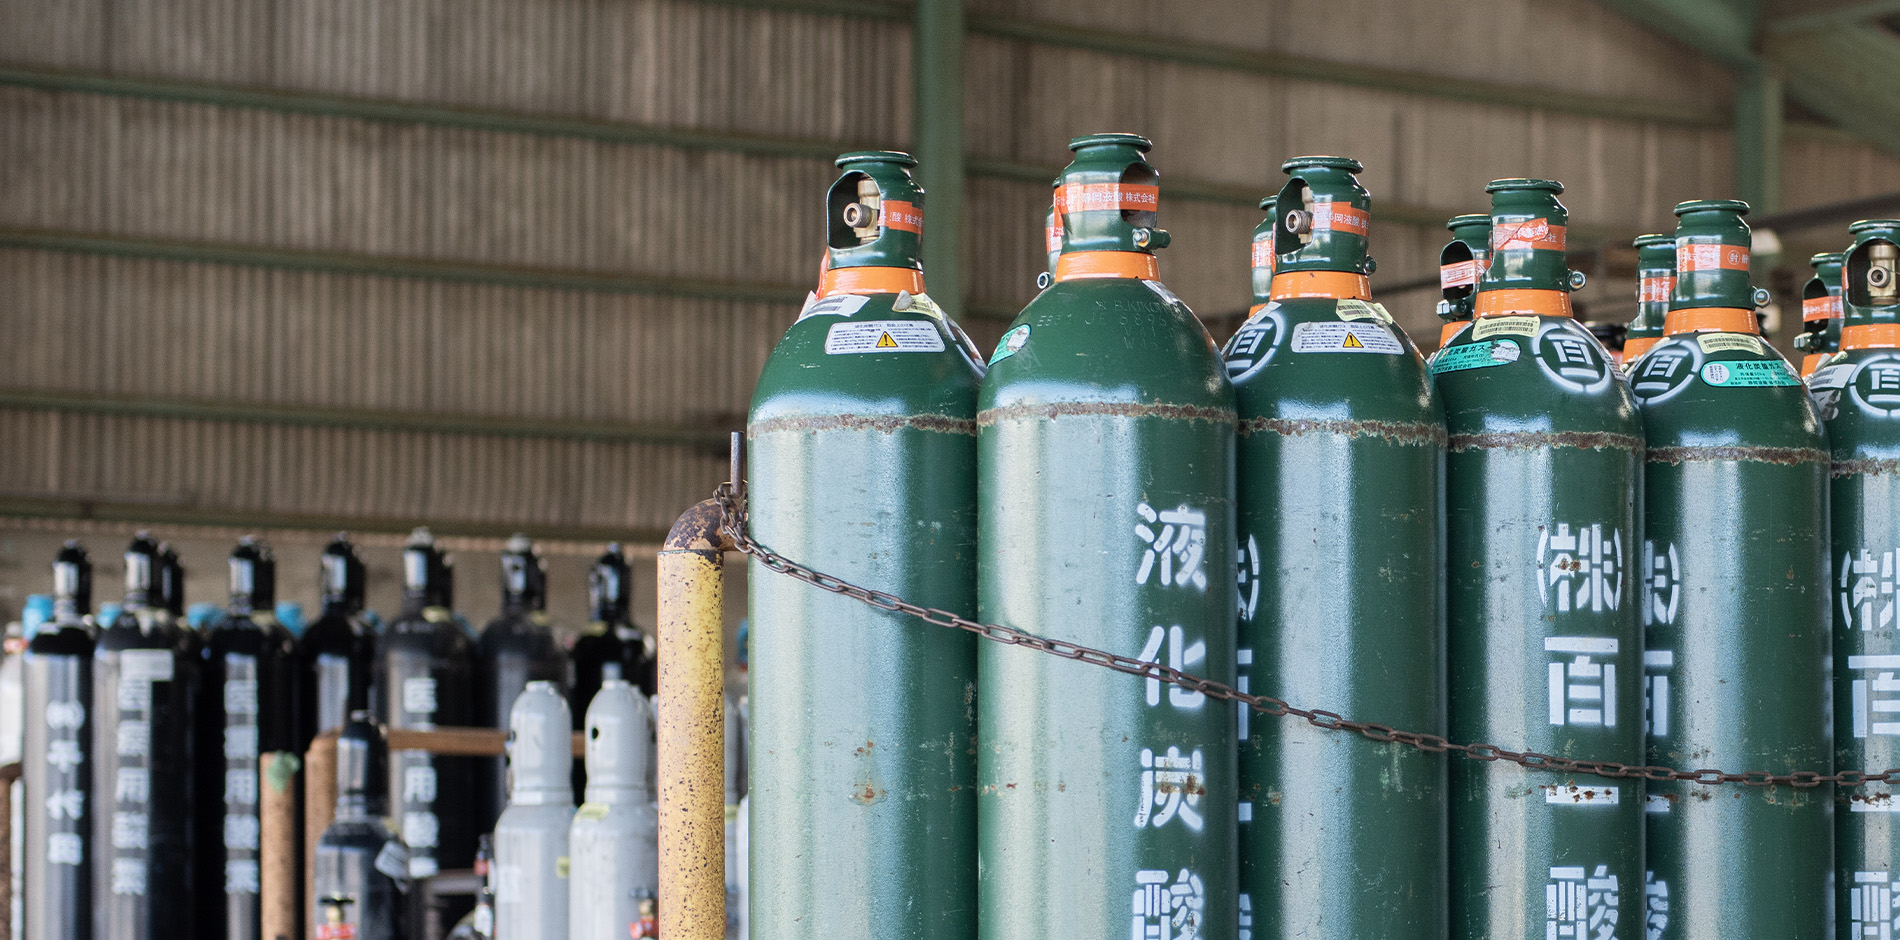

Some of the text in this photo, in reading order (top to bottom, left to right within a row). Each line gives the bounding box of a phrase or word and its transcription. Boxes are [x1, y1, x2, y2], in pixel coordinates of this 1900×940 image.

[1125, 191, 1156, 205] 株式会社
[1132, 502, 1206, 940] 液化炭酸
